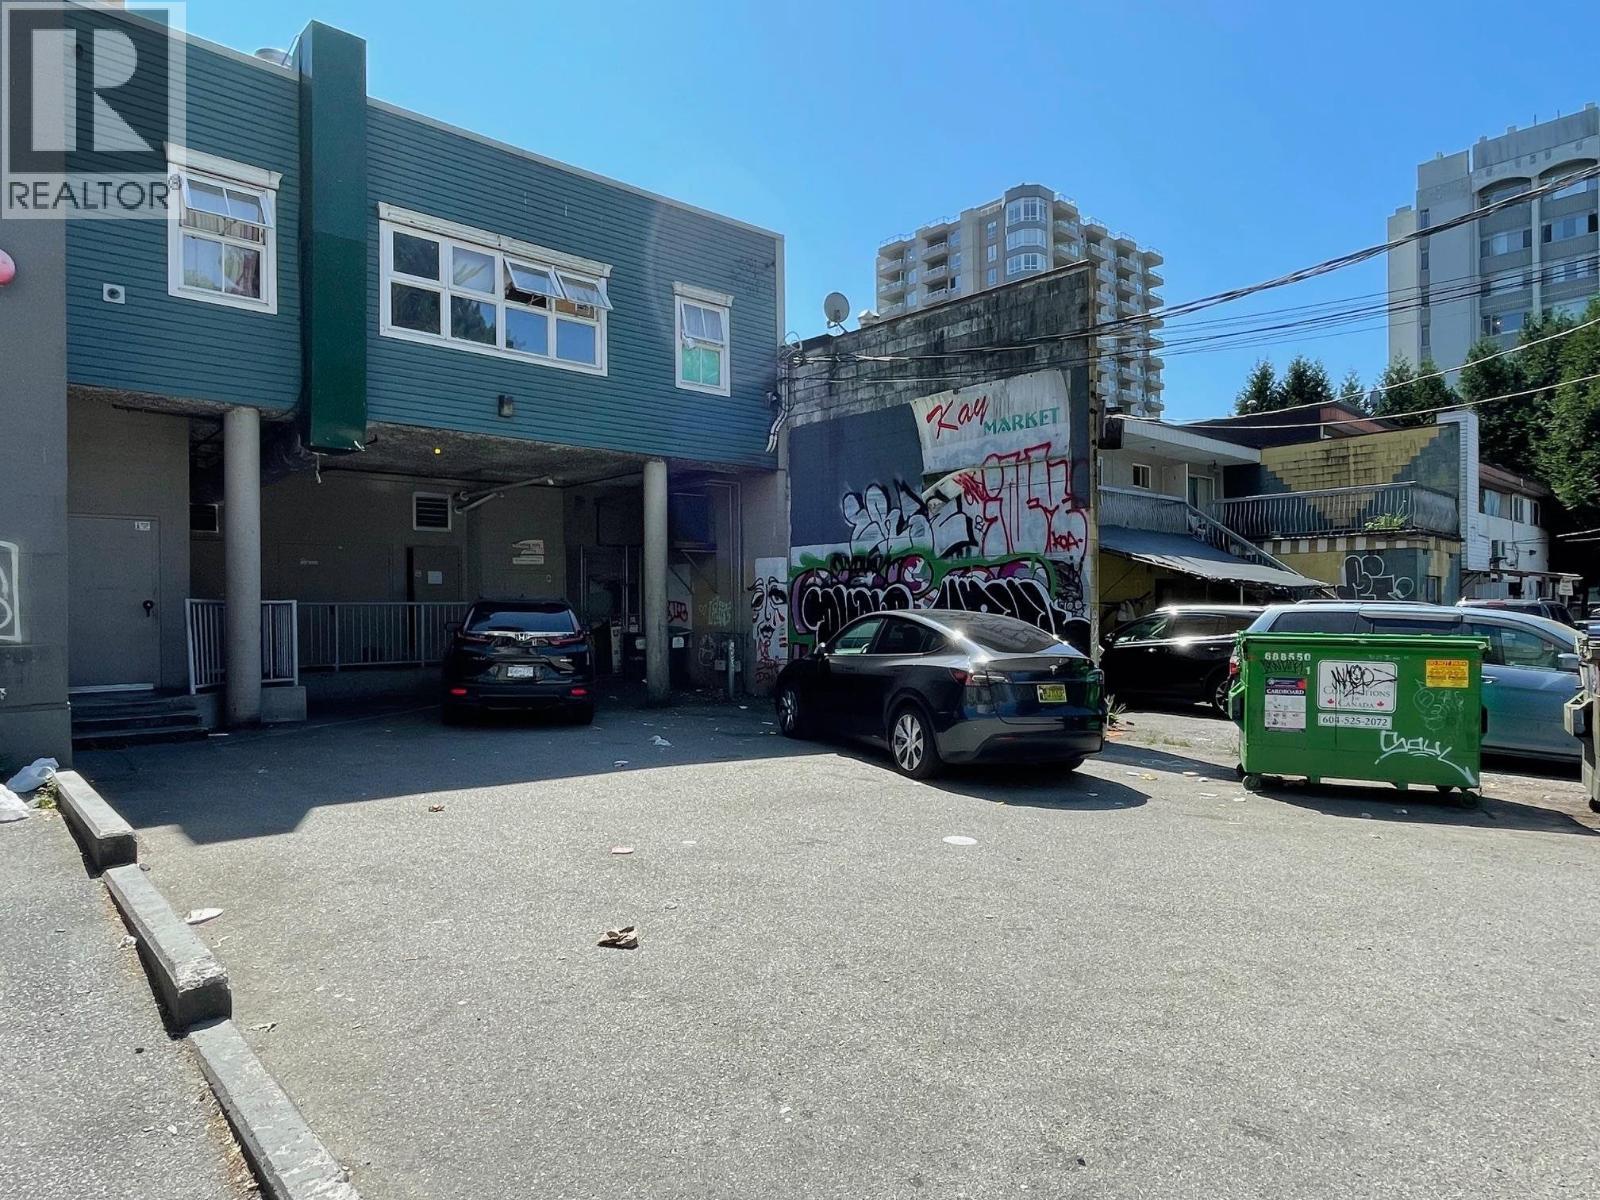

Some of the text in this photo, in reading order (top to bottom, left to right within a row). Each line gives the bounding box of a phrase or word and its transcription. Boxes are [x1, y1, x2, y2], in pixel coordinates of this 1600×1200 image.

[926, 396, 989, 439] Kay
[983, 406, 1061, 437] MARKET
[1266, 688, 1305, 696] CARDBOARD
[1322, 715, 1388, 728] 604-525-2072
